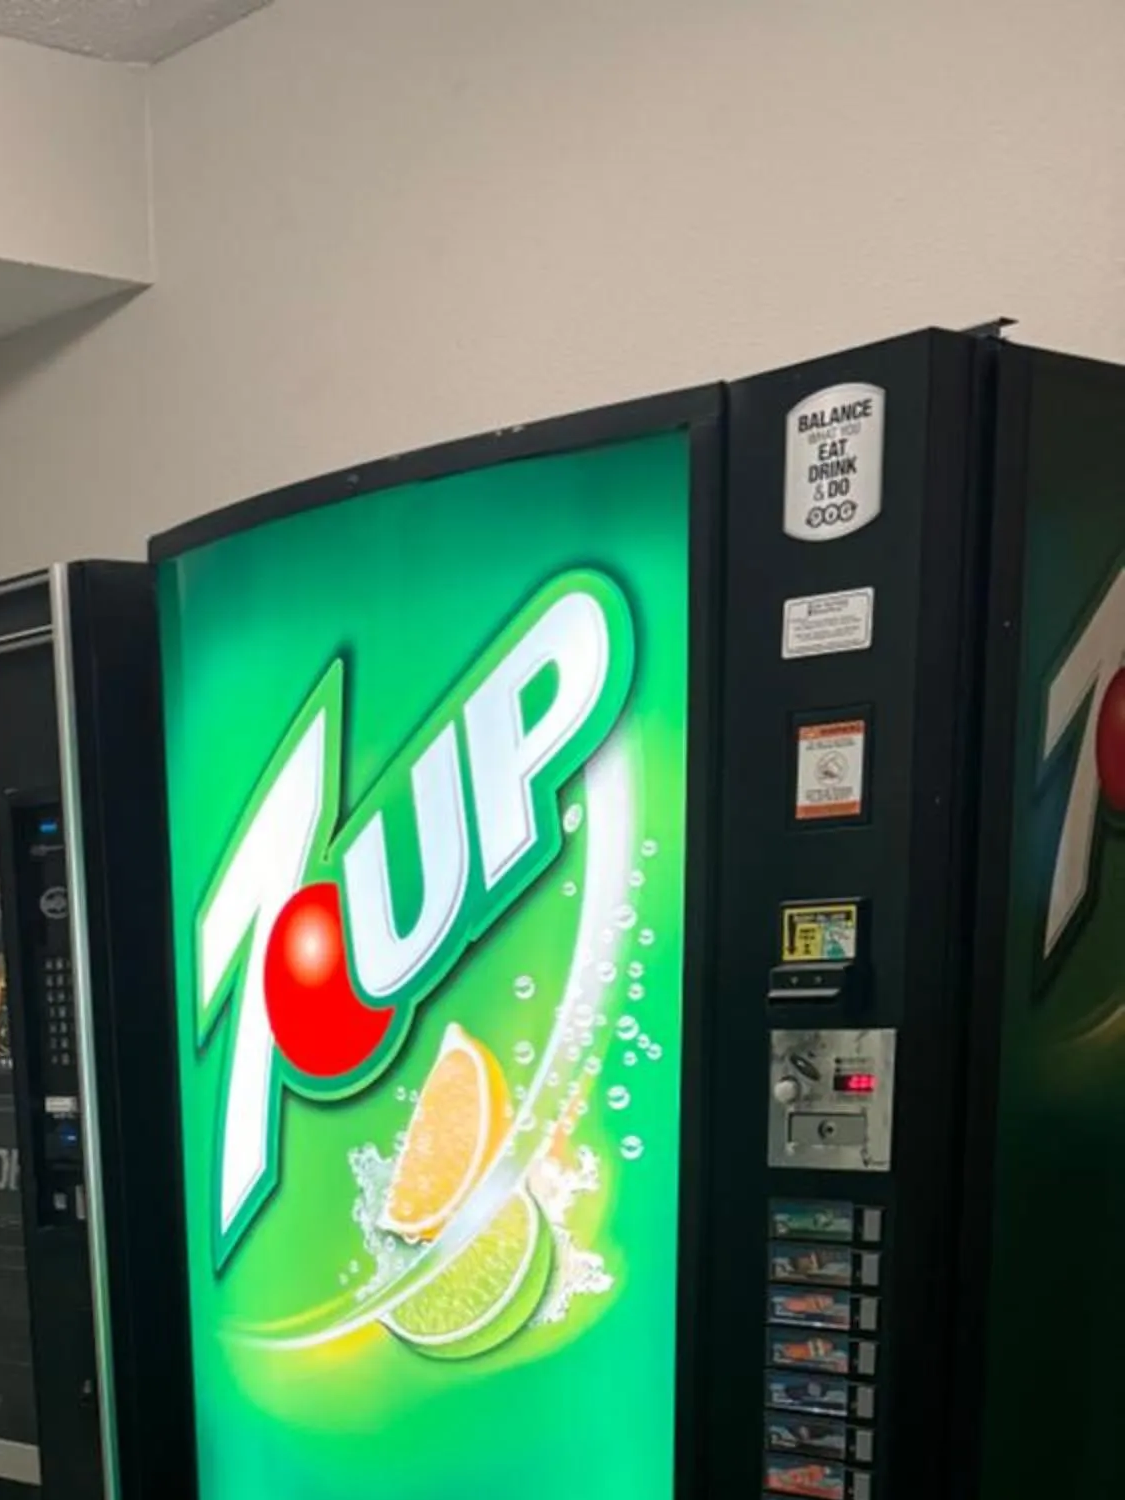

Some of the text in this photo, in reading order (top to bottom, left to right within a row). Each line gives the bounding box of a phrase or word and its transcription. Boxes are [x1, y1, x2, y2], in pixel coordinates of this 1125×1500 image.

[798, 398, 873, 432] BALANCE
[818, 438, 848, 461] EAT
[808, 456, 858, 483] DRINK
[813, 478, 850, 501] & DO
